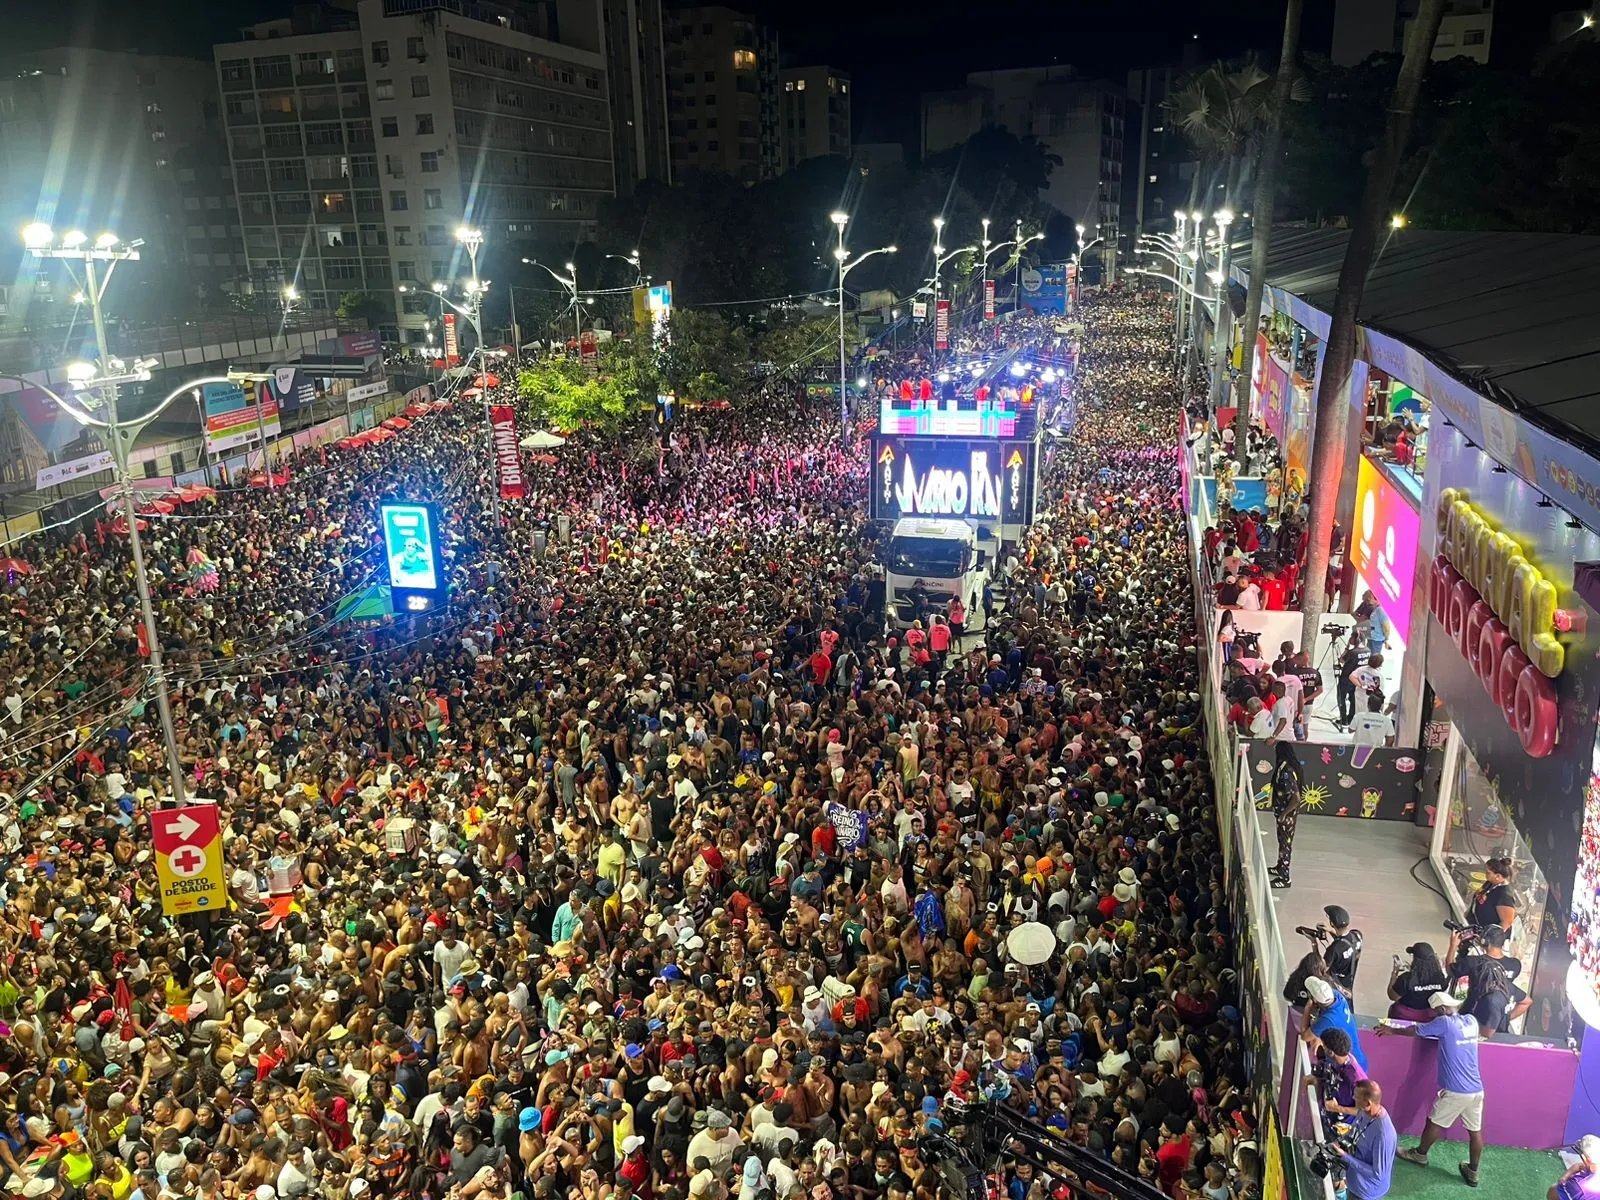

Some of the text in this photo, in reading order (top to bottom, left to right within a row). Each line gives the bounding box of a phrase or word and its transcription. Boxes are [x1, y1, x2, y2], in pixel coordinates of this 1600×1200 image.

[985, 287, 995, 313] BRAHMA
[445, 322, 458, 356] BRAHMA
[936, 308, 948, 342] BRAHMA
[494, 420, 521, 485] BRAHMA
[1436, 487, 1564, 677] CARNAVAL
[832, 813, 854, 827] REINO
[165, 888, 181, 897] DE
[172, 877, 208, 889] POSTO
